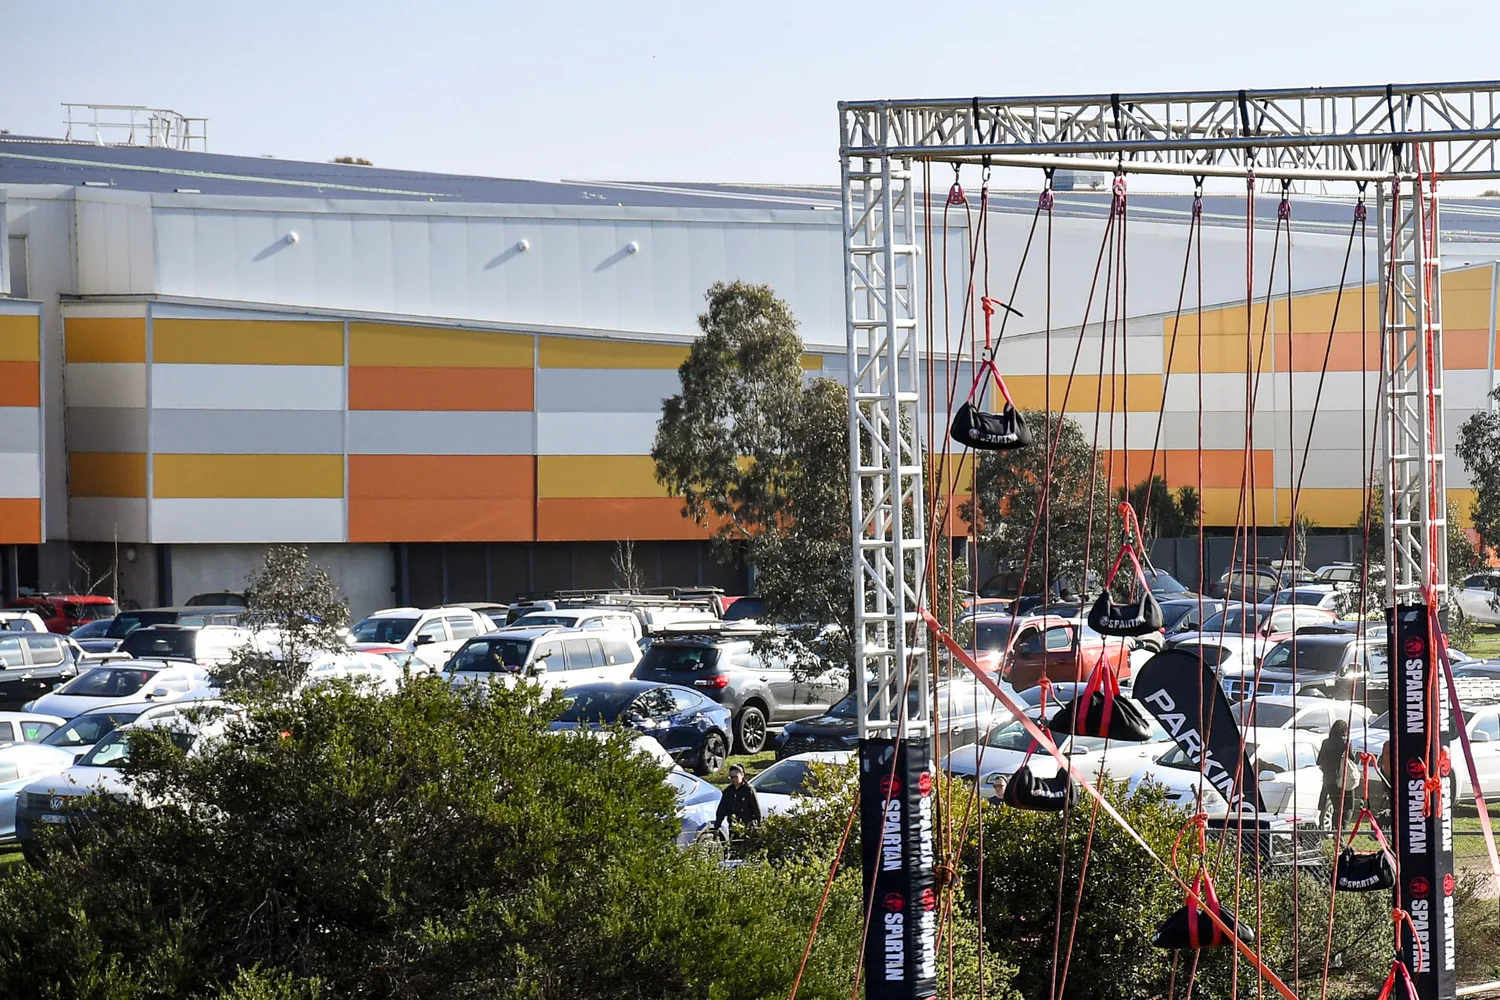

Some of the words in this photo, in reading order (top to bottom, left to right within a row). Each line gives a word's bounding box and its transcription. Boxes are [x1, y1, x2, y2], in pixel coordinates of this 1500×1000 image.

[1405, 659, 1424, 733] SPARTAN
[1408, 779, 1426, 853] SPARTAN
[1441, 777, 1452, 852] SPARTAN
[1347, 875, 1379, 888] SPARTAN
[1411, 899, 1430, 973] SPARTAN
[1443, 896, 1455, 970] SPARTAN
